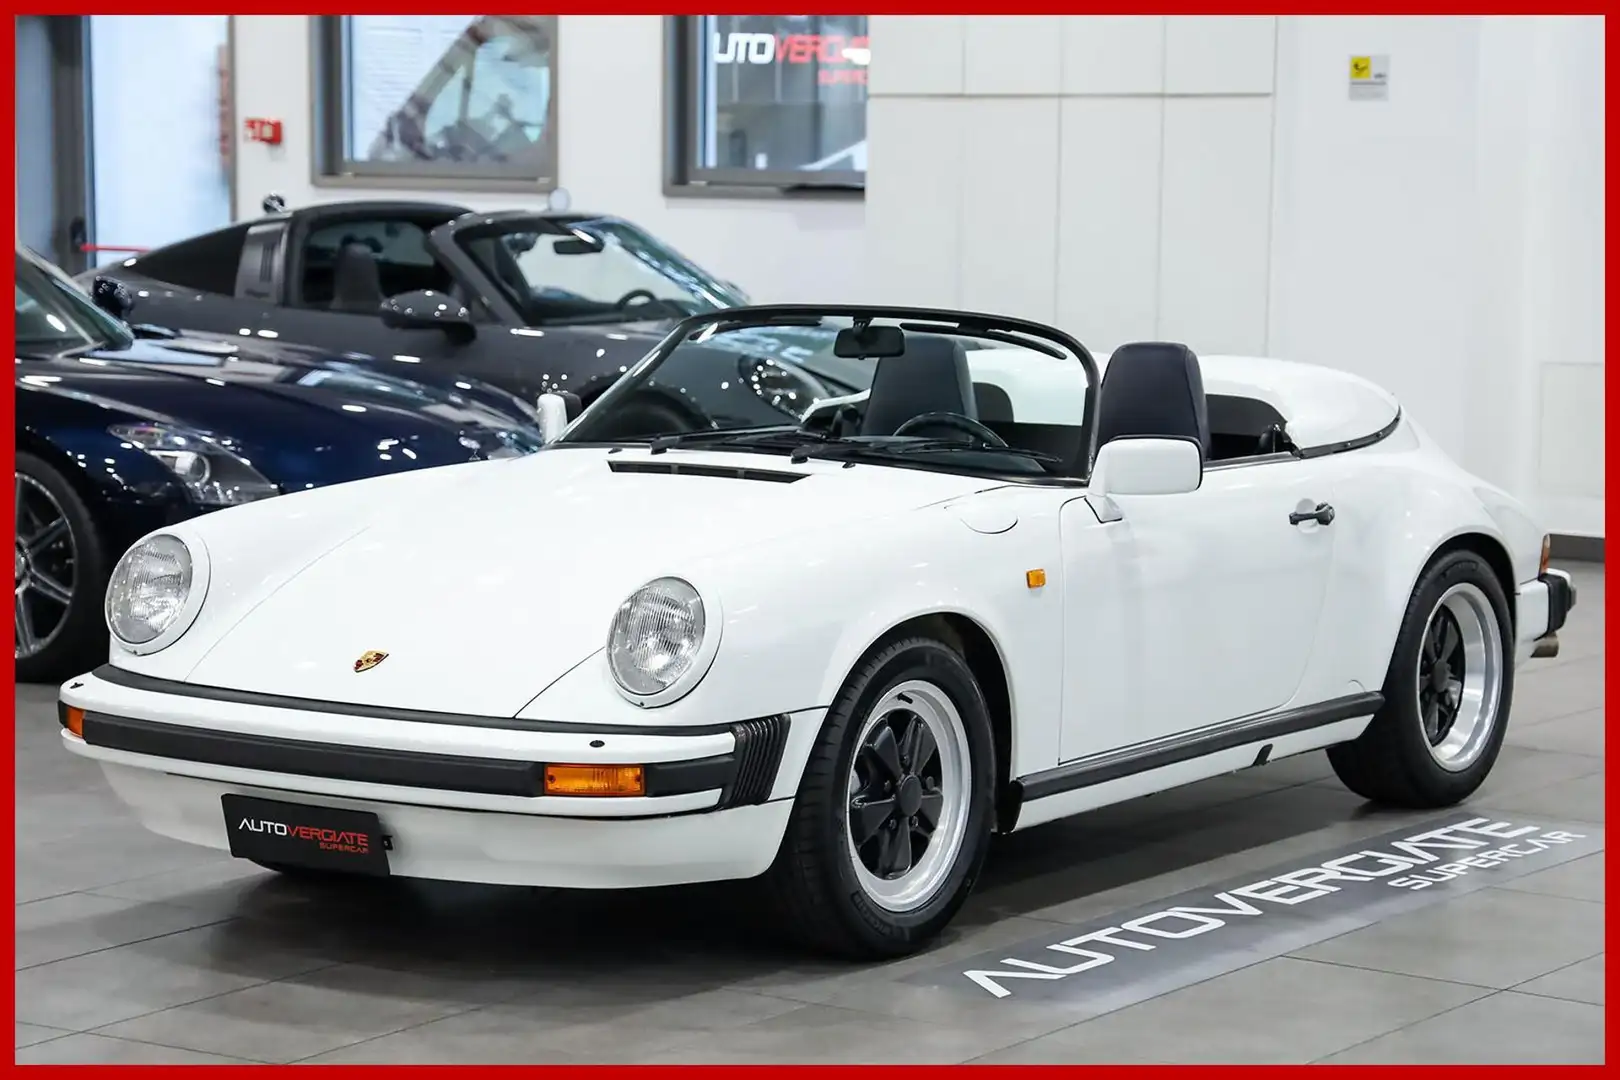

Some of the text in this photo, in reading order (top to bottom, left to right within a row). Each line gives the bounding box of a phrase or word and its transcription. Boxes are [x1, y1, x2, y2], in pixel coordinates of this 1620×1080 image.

[238, 818, 369, 847] AUTOVERGIATE
[319, 841, 370, 854] SUPERCAR
[1387, 830, 1587, 890] SUPERCAR
[962, 817, 1542, 999] AUTOVERGIATE
